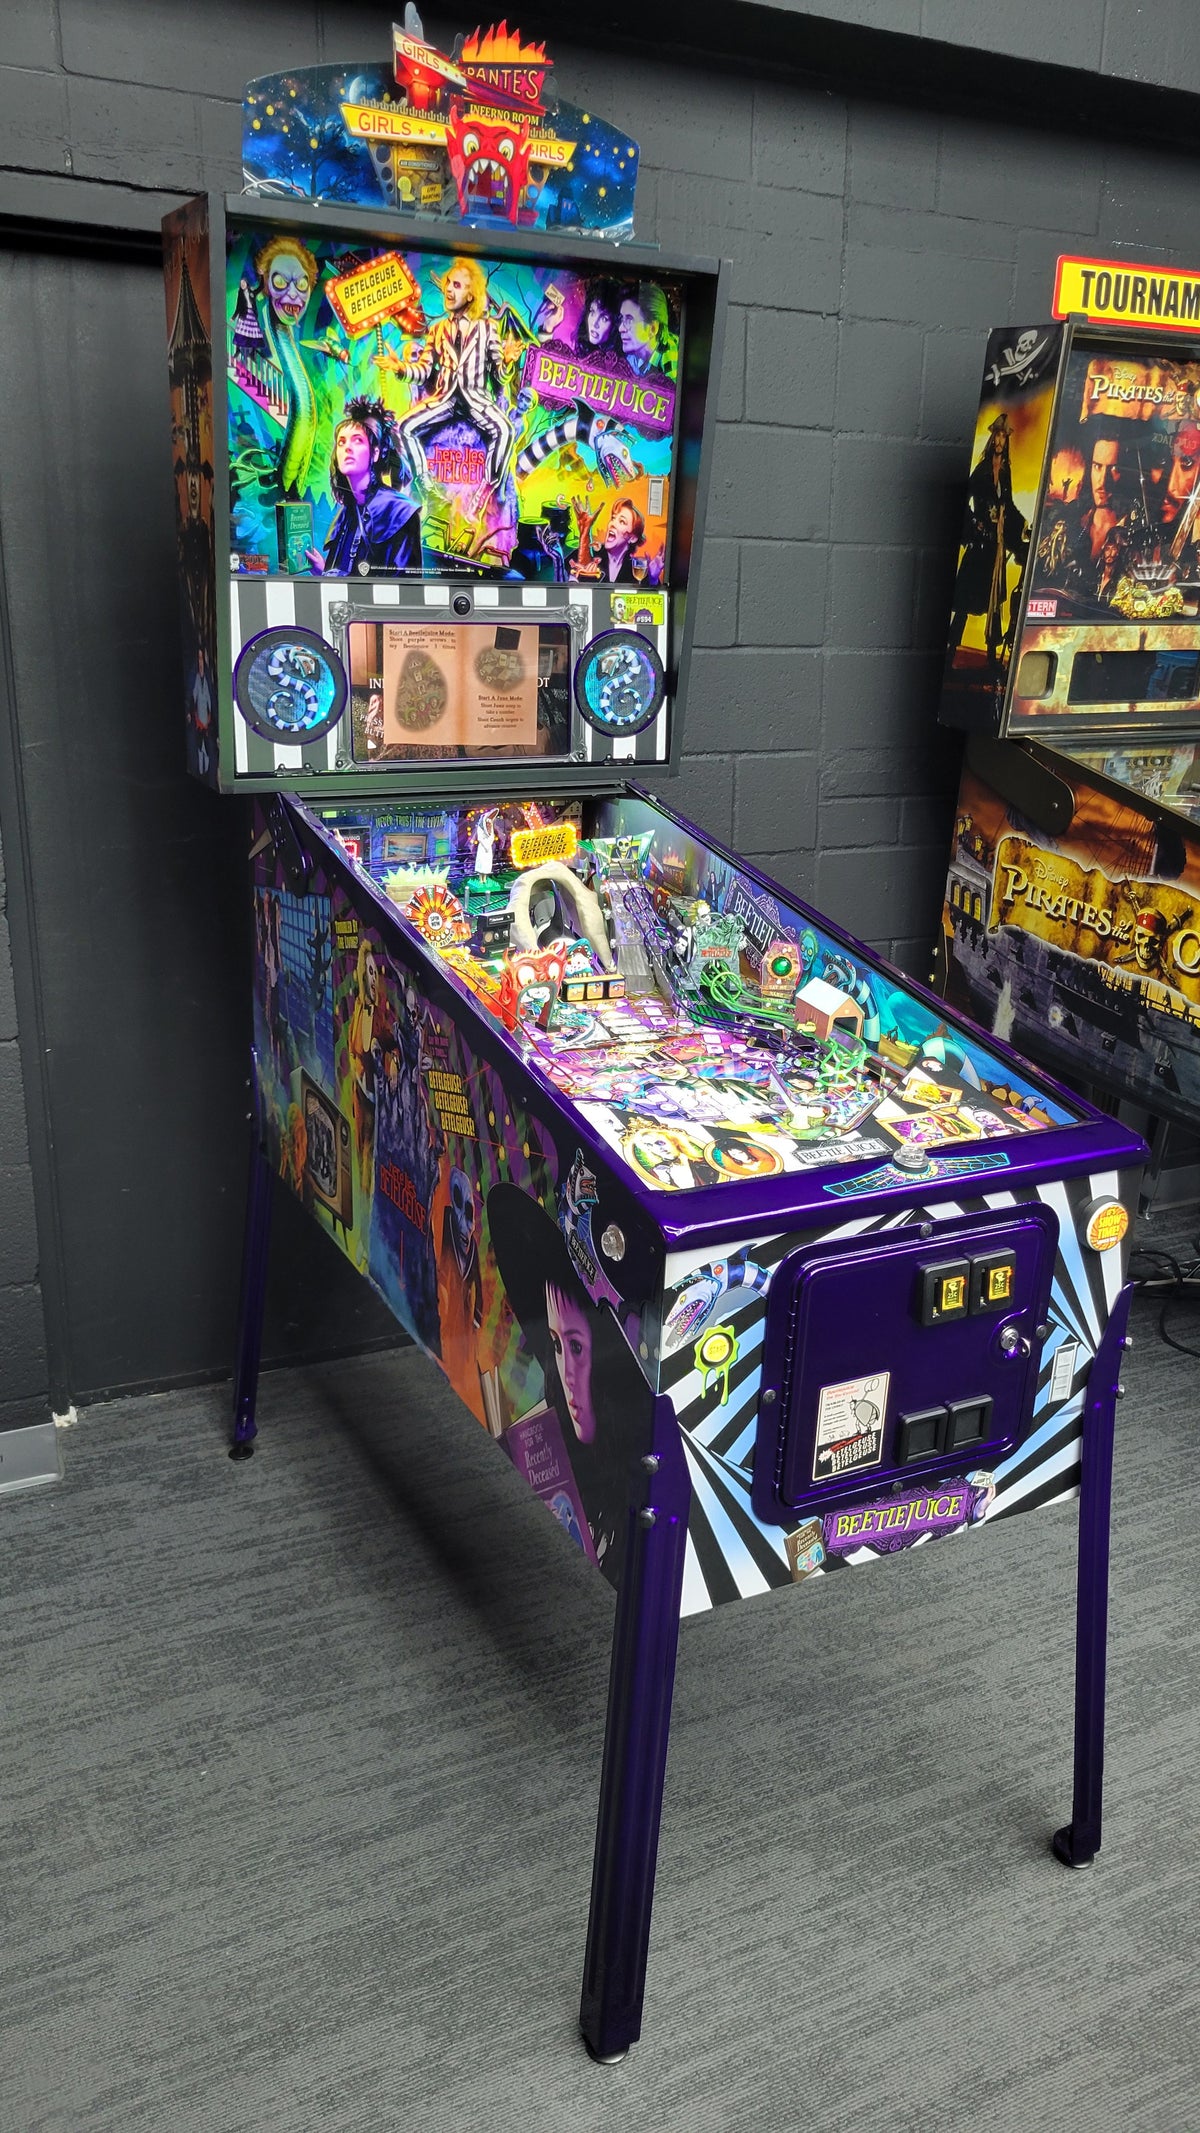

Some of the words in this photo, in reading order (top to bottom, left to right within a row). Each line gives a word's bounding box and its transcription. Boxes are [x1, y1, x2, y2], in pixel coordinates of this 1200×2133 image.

[402, 39, 440, 70] GIRLS
[466, 67, 538, 100] DANTE'S
[358, 112, 412, 136] GIRLS
[470, 103, 510, 123] INFERNO
[344, 265, 396, 299] BETELGEUSE
[350, 279, 404, 314] BETELGEUSE
[1114, 366, 1137, 384] Disney
[539, 356, 670, 422] BEETLEJUICE
[1090, 375, 1163, 403] PIRATES
[434, 444, 462, 462] here
[370, 678, 384, 689] IN
[395, 815, 412, 827] TRUST
[415, 816, 426, 828] THE
[521, 833, 566, 849] BETELGEUSE
[522, 843, 567, 860] BETELGEUSE
[1034, 858, 1069, 891] Disney
[1001, 862, 1113, 936] PIRATES
[1111, 926, 1130, 941] the
[1119, 919, 1132, 931] of
[428, 1070, 462, 1093] BETELGEUSE!
[434, 1091, 469, 1115] BETELGEUSE!
[441, 1111, 475, 1137] BETELGEUSE!
[801, 1147, 844, 1160] BEETLE
[844, 1141, 880, 1155] JUICE
[1097, 1225, 1119, 1240] TIME!
[1099, 1214, 1121, 1228] SHOW
[525, 1437, 534, 1448] FOR
[535, 1433, 543, 1443] THE
[831, 1438, 877, 1466] BETELGEUSE
[525, 1442, 553, 1469] Recently
[832, 1444, 877, 1472] BETELGEUSE
[528, 1459, 560, 1487] Deceased
[835, 1495, 963, 1538] BEETLEJUICE
